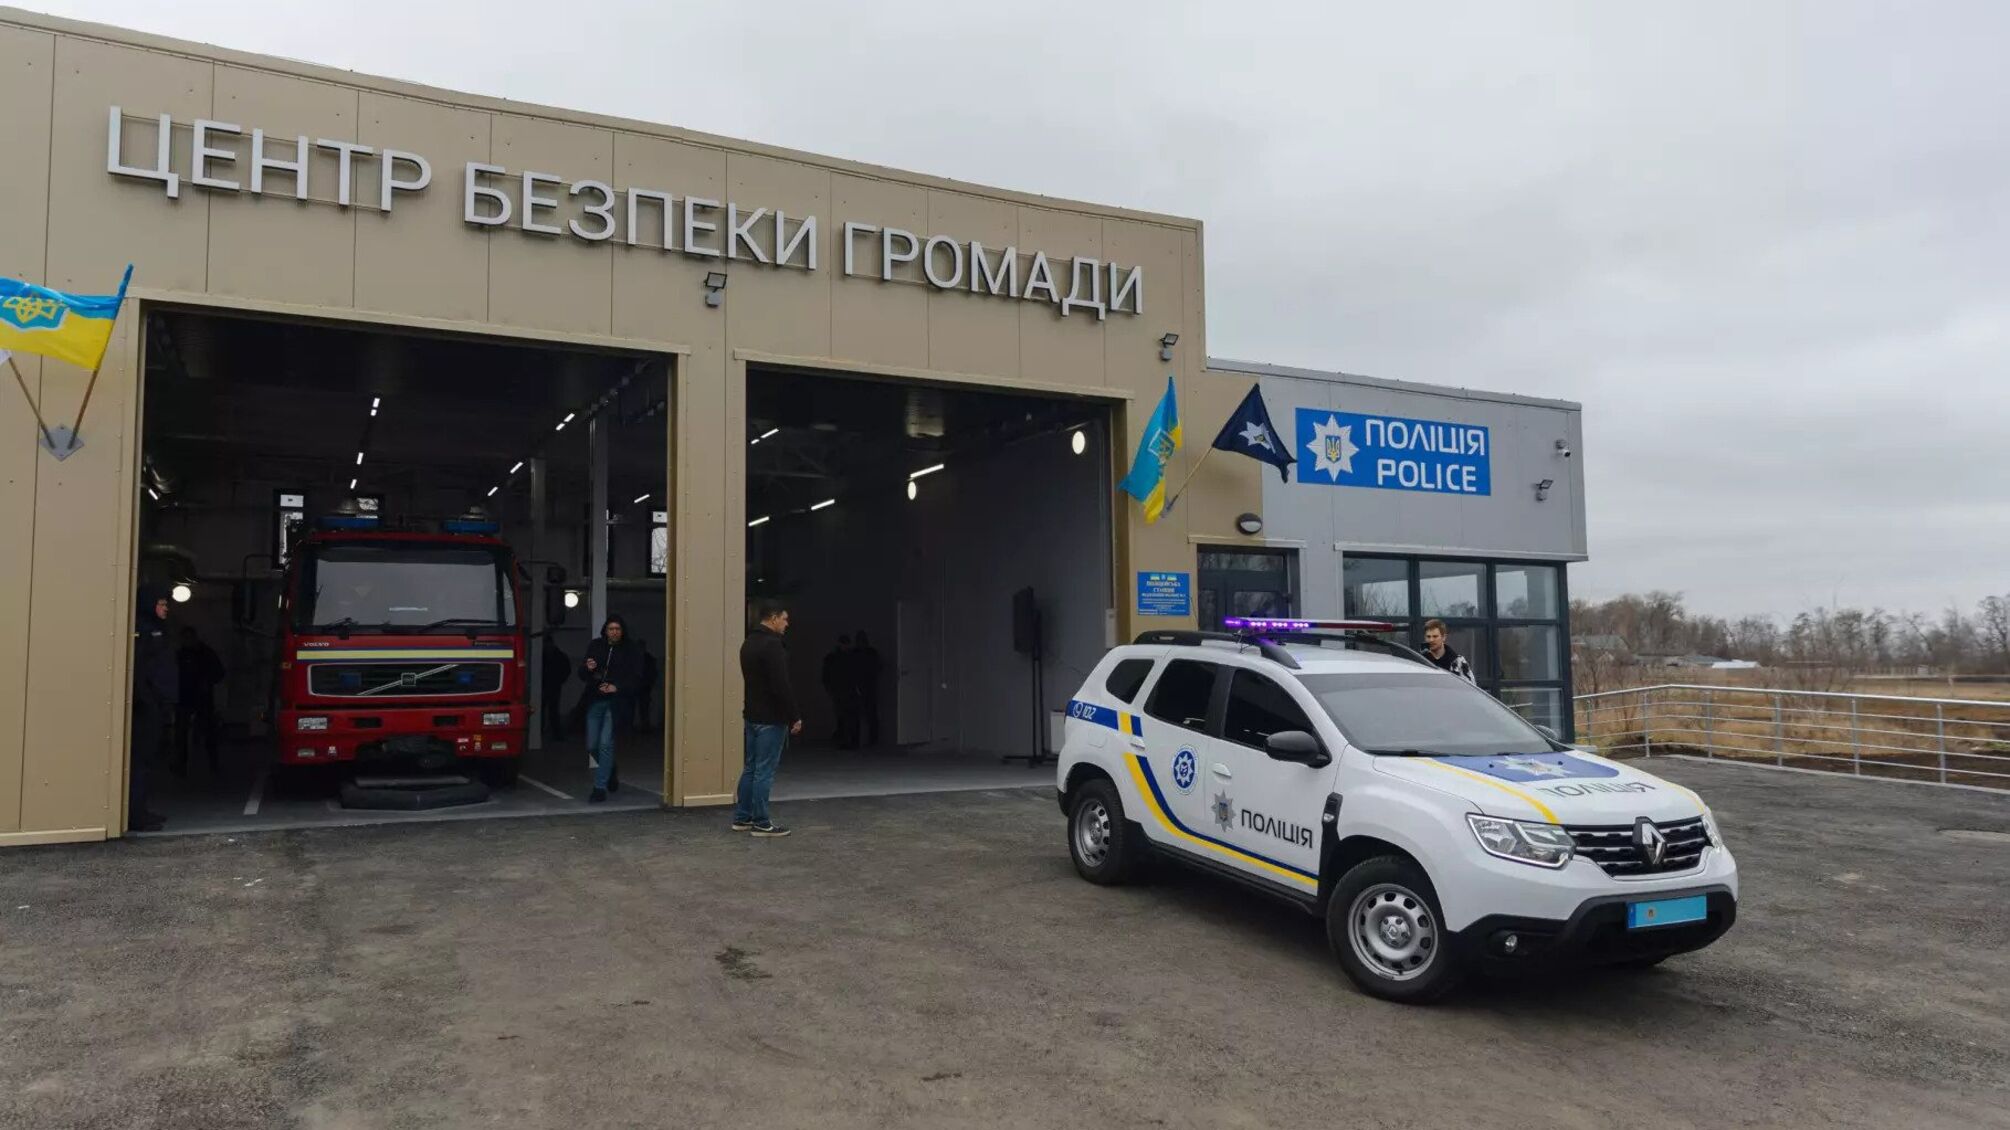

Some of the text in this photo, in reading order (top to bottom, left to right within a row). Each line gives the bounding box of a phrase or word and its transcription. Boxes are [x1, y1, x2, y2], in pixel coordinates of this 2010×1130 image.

[107, 106, 1144, 321] ЦЕНТР БЕЗПЕКИ ГРОМАДИ
[1365, 419, 1485, 456] ПОЛІЦІЯ
[1377, 458, 1477, 493] POLICE
[1082, 705, 1097, 720] 102
[1241, 808, 1313, 849] ПОЛІЦІЯ
